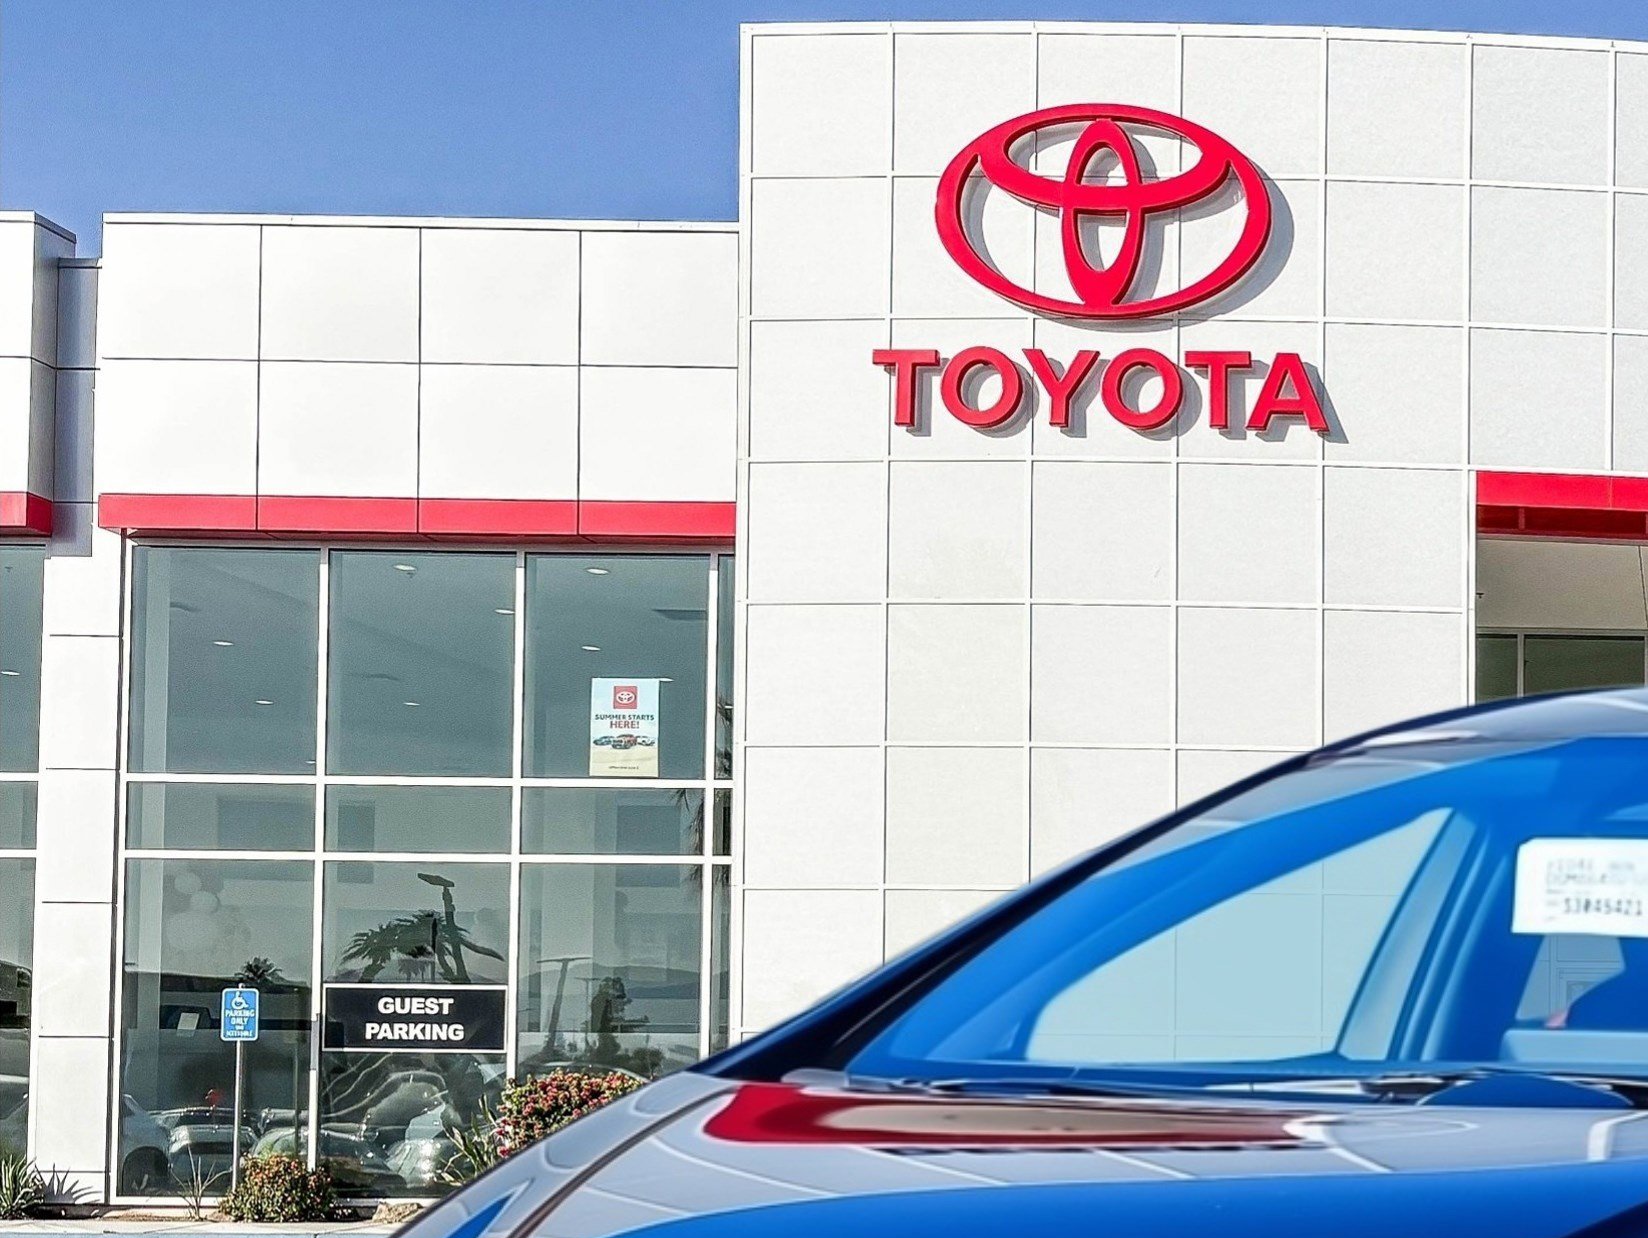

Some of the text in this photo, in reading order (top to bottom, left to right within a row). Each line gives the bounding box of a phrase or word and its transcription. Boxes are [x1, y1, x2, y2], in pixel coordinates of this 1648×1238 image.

[872, 346, 1329, 434] TOYOTA
[610, 720, 640, 729] HERE!
[377, 996, 455, 1015] GUEST
[365, 1022, 465, 1041] PARKING
